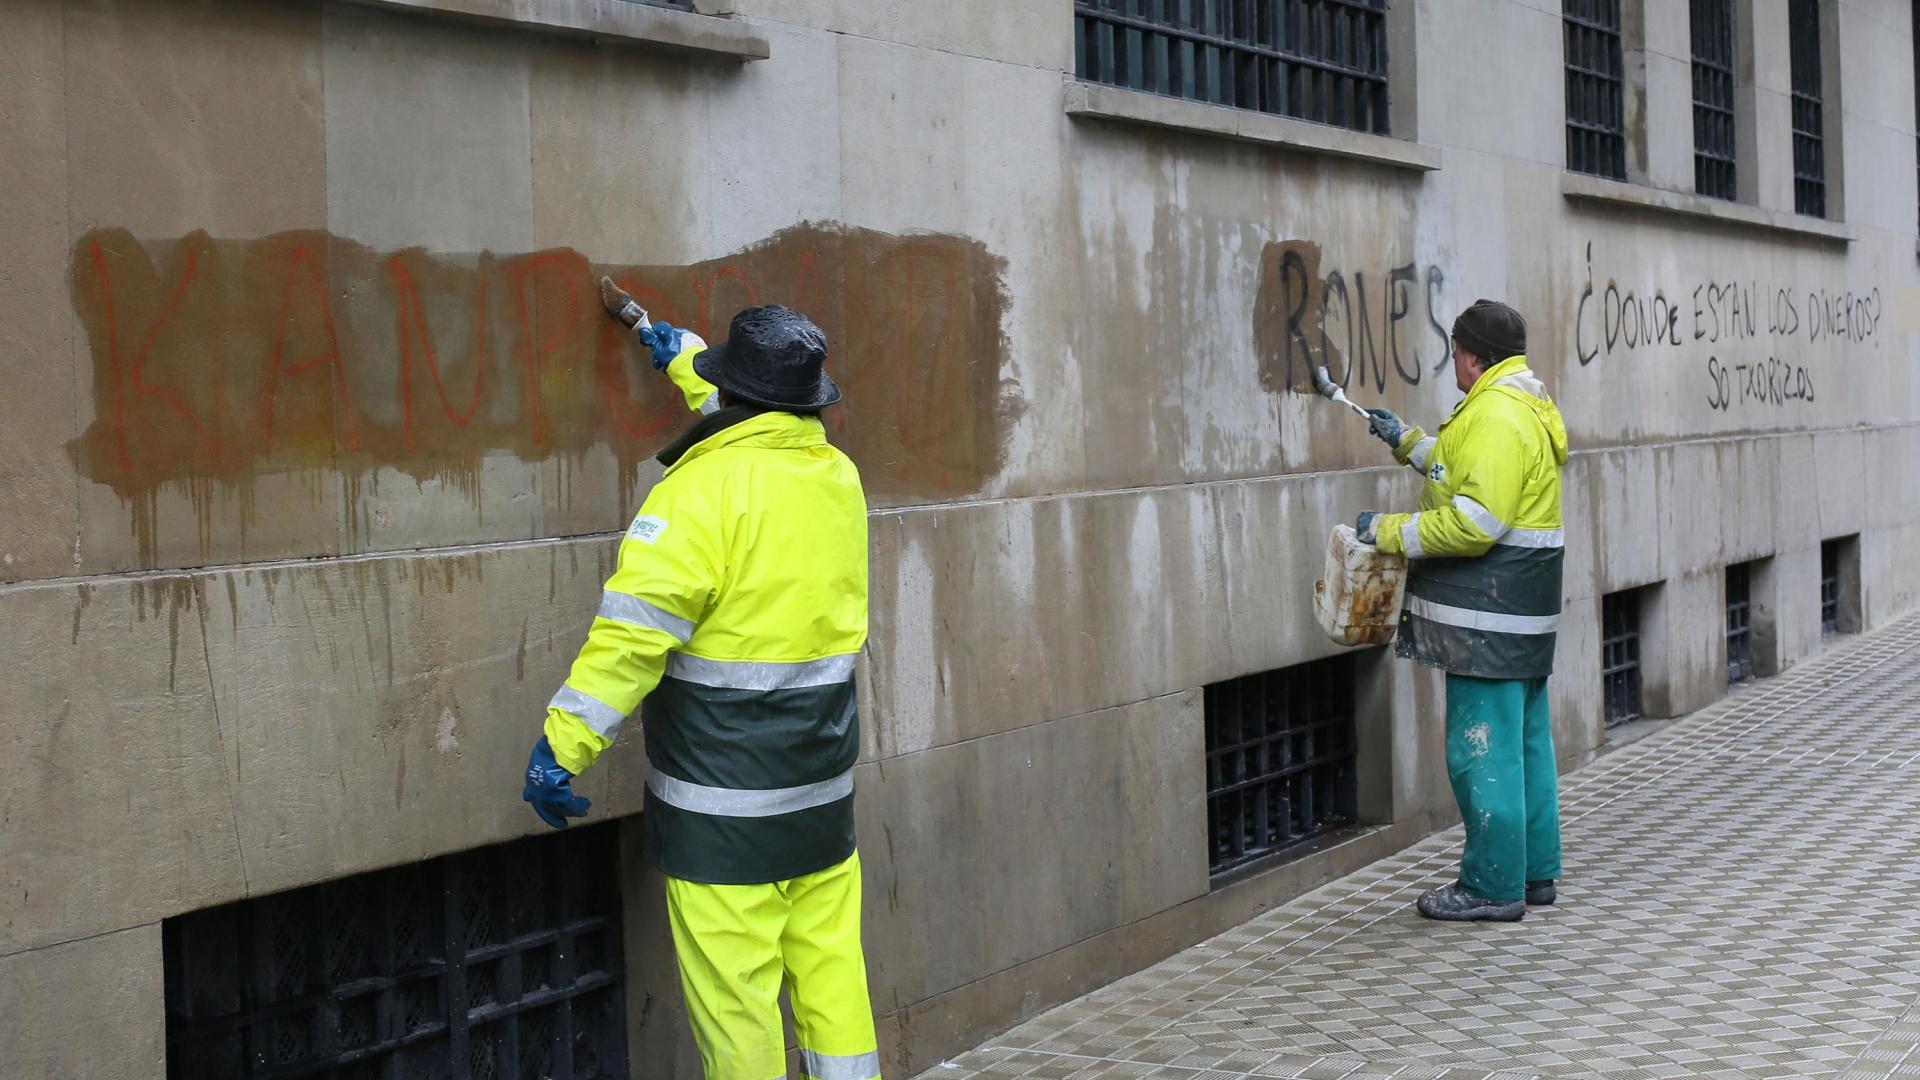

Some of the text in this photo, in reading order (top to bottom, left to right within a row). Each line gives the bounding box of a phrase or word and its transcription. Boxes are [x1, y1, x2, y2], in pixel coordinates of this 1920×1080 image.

[1693, 279, 1757, 343] ESTAN
[1767, 284, 1799, 335] LOS
[1707, 356, 1730, 412] SO
